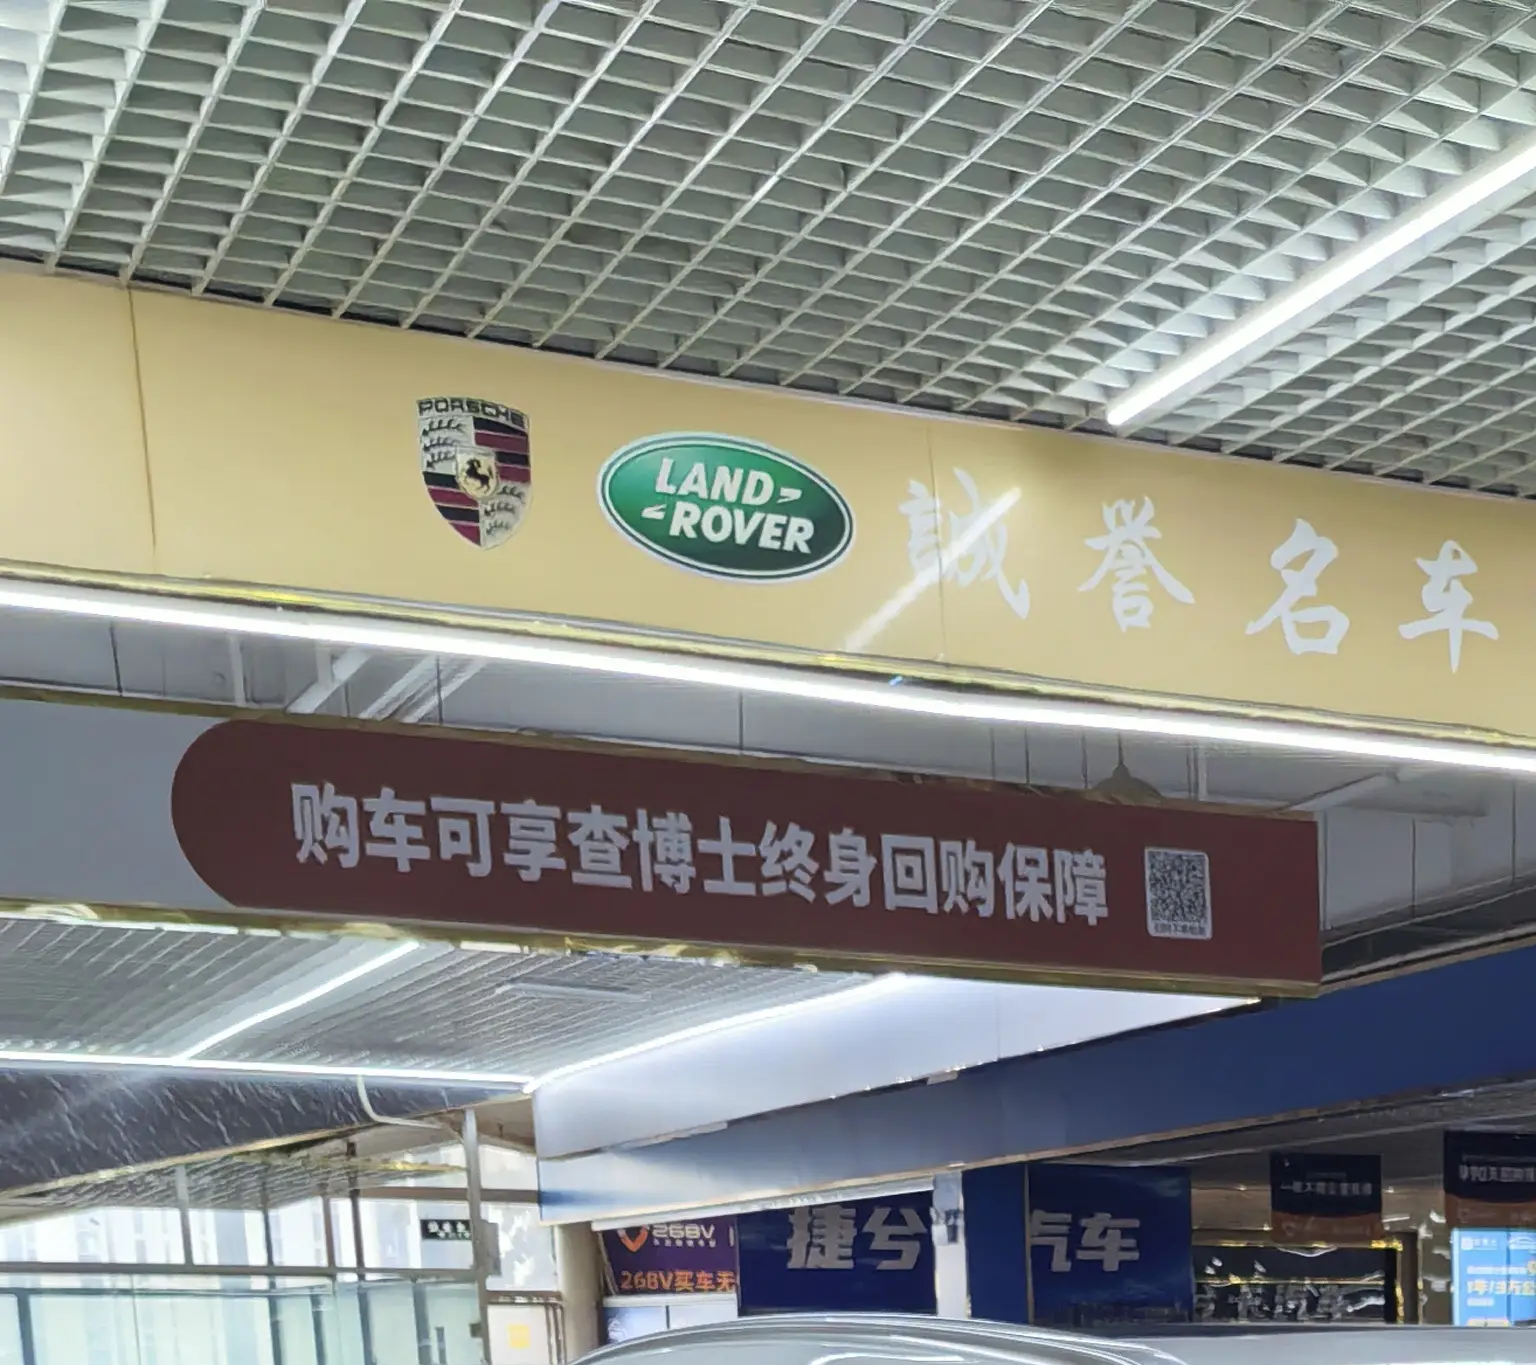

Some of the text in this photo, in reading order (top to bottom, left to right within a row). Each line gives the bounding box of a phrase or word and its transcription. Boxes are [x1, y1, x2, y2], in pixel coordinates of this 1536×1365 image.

[417, 397, 528, 430] PORSCHE
[655, 457, 774, 503] LAND
[669, 500, 815, 554] ROVER
[290, 782, 1109, 926] 购车可享查博士终身回购保障
[652, 1223, 715, 1239] 268V
[786, 1206, 926, 1270] 捷兮
